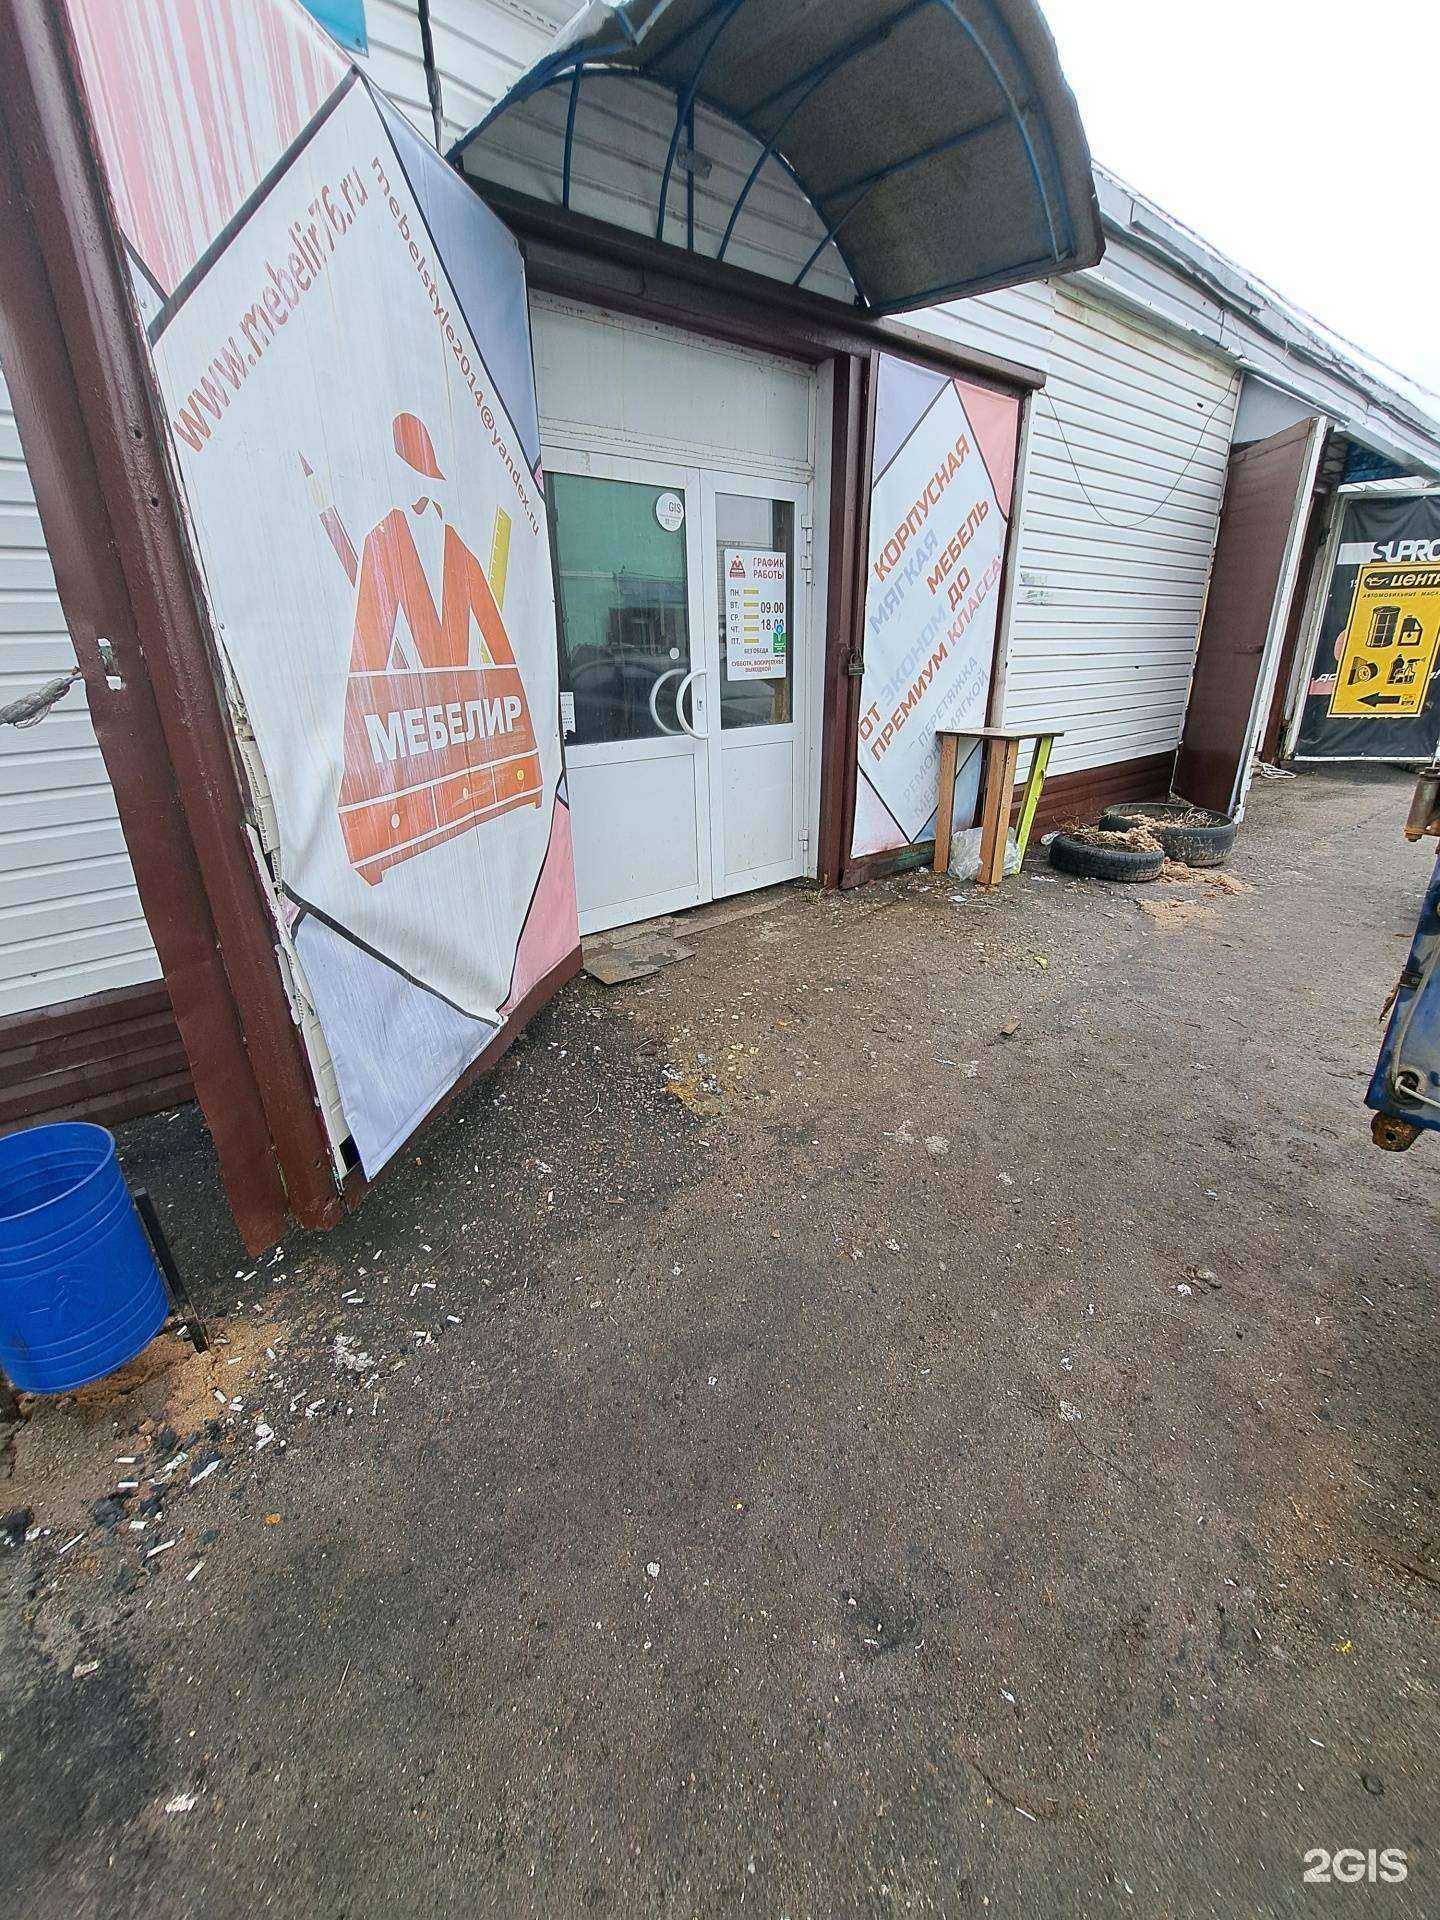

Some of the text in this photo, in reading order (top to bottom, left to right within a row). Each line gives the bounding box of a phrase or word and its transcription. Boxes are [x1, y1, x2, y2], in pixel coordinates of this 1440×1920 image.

[173, 166, 368, 453] www.mebelir76.ru
[371, 156, 541, 536] mebelstyle2014@yandex.ru
[753, 557, 785, 568] ГРАФИК
[873, 433, 970, 583] КОРПУСНАЯ
[753, 569, 785, 580] РАБОТЫ
[760, 601, 785, 614] 09.00
[869, 500, 989, 634] МЯГКАЯ МЕБЕЛЬ
[858, 567, 971, 741] ОТ ЭКОНОМ ДО
[871, 556, 1002, 762] ПРЕМИУМ КЛАССА
[917, 656, 979, 749] ПЕРЕТЯЖКА
[363, 695, 522, 765] МЕБЕЛИР
[903, 736, 942, 802] РЕМОН
